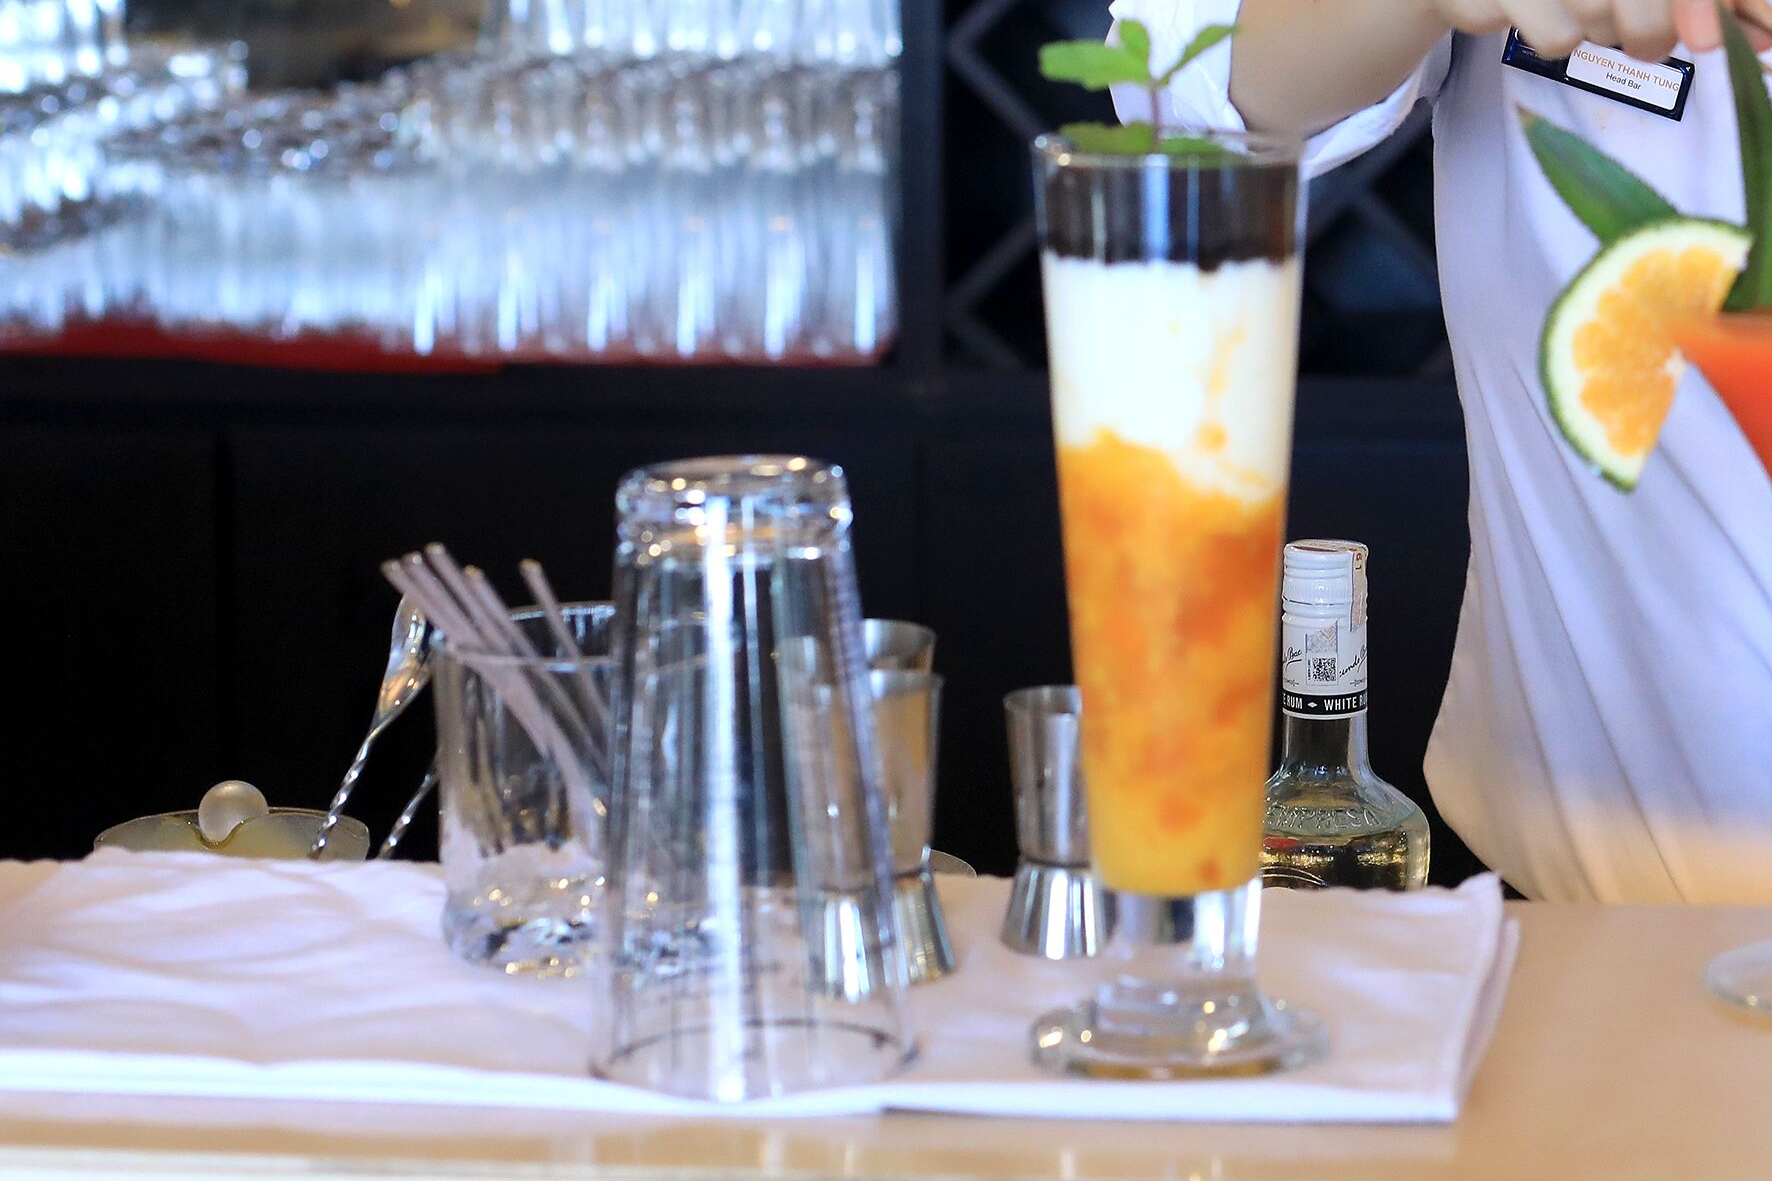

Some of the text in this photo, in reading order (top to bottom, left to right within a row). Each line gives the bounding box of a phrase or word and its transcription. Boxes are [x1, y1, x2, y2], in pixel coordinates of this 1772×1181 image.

[1573, 49, 1680, 92] NGUYEN THANH TUNG
[1605, 72, 1642, 90] Head Bar
[1286, 694, 1303, 710] RUM
[1324, 696, 1358, 711] WHITE
